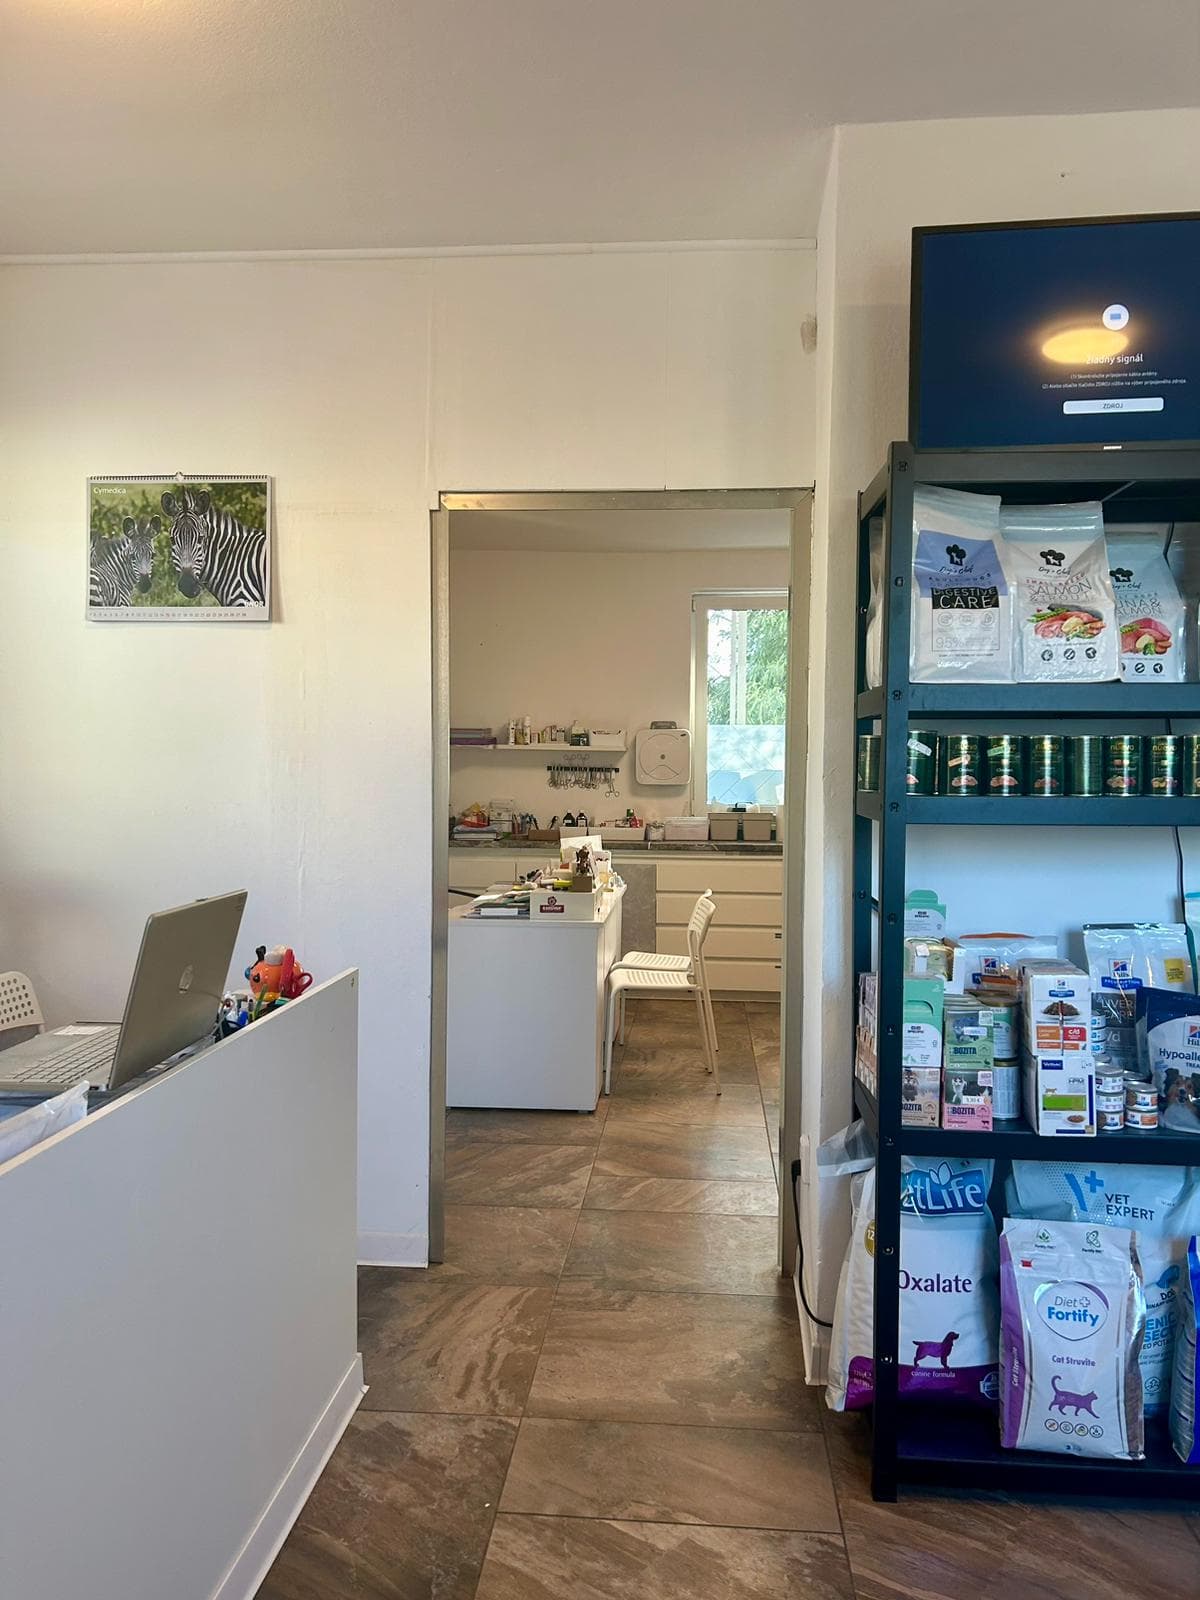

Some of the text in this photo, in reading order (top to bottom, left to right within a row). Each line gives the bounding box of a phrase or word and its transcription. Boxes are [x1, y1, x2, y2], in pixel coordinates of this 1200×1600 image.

[1116, 353, 1144, 365] signál
[1102, 402, 1124, 410] ZDROJ
[93, 486, 127, 496] Cymedica
[932, 586, 997, 597] DIGESTIVE
[1028, 577, 1093, 596] SALMON
[940, 594, 993, 609] CARE
[953, 1046, 977, 1055] BOZITA
[952, 1106, 976, 1115] BOZITA
[1105, 1193, 1130, 1205] VET
[1105, 1204, 1155, 1221] EXPERT
[899, 1268, 972, 1293] Oxalate
[1054, 1295, 1078, 1308] Diet
[1047, 1306, 1100, 1327] Fortify
[1051, 1354, 1096, 1367] Cat Struvite
